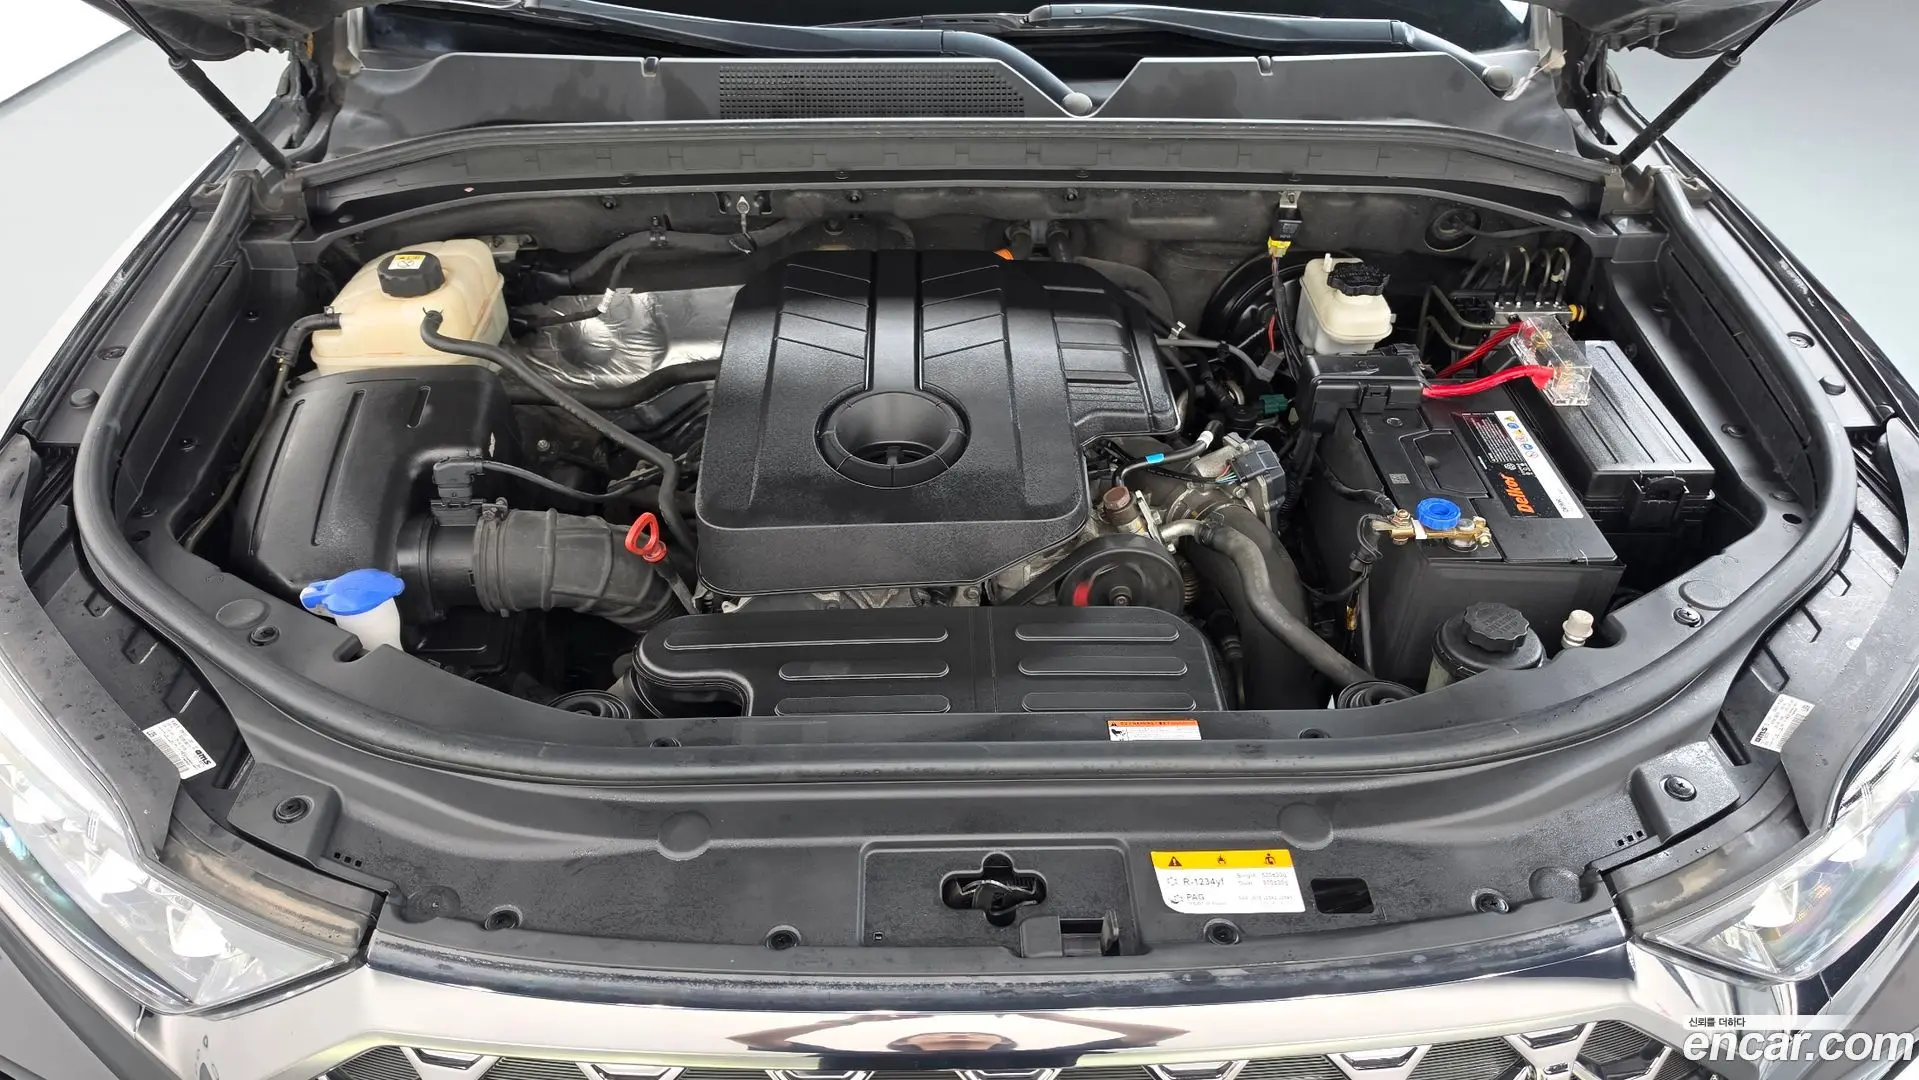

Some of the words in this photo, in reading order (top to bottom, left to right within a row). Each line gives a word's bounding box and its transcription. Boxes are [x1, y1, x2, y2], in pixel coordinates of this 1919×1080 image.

[1500, 472, 1535, 513] Delkor
[195, 749, 212, 765] ams
[1186, 893, 1205, 901] PAG
